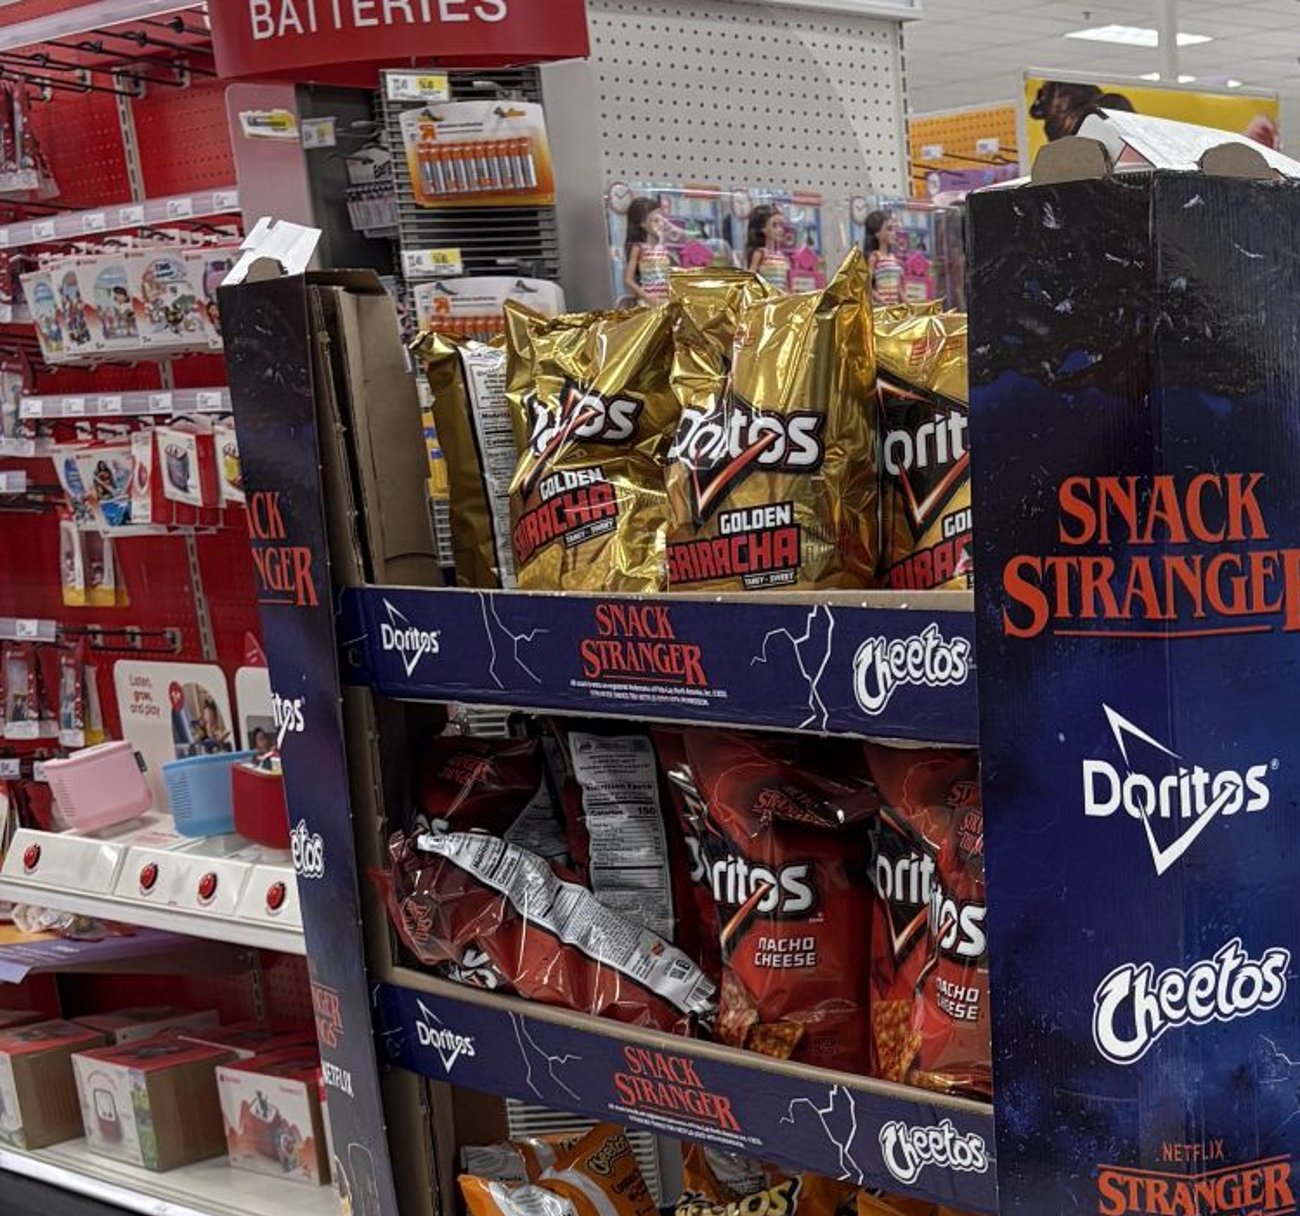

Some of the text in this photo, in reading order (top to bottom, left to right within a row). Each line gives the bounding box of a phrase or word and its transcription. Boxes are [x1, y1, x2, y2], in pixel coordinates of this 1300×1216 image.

[250, 0, 507, 40] BATTERIES
[883, 410, 969, 476] orit
[540, 468, 604, 500] GOLDEN
[720, 505, 791, 534] GOLDEN
[1057, 472, 1270, 546] SNACK
[381, 623, 439, 654] Doritos
[595, 604, 675, 639] SNACK
[581, 638, 708, 686] STRANGER
[853, 622, 971, 715] Cheetos
[271, 694, 305, 732] itos
[1083, 759, 1271, 819] Doritos
[289, 819, 323, 879] etos
[702, 848, 814, 913] ritos
[876, 851, 935, 904] orit
[754, 952, 817, 968] CHEESE
[757, 936, 815, 952] NACHO
[1092, 937, 1291, 1064] Cheetos
[415, 1020, 475, 1057] Doritos
[623, 1045, 704, 1089] SNACK
[614, 1072, 743, 1132] STRANGER
[878, 1118, 988, 1184] Cheetos
[1161, 1139, 1225, 1163] NETFLIX
